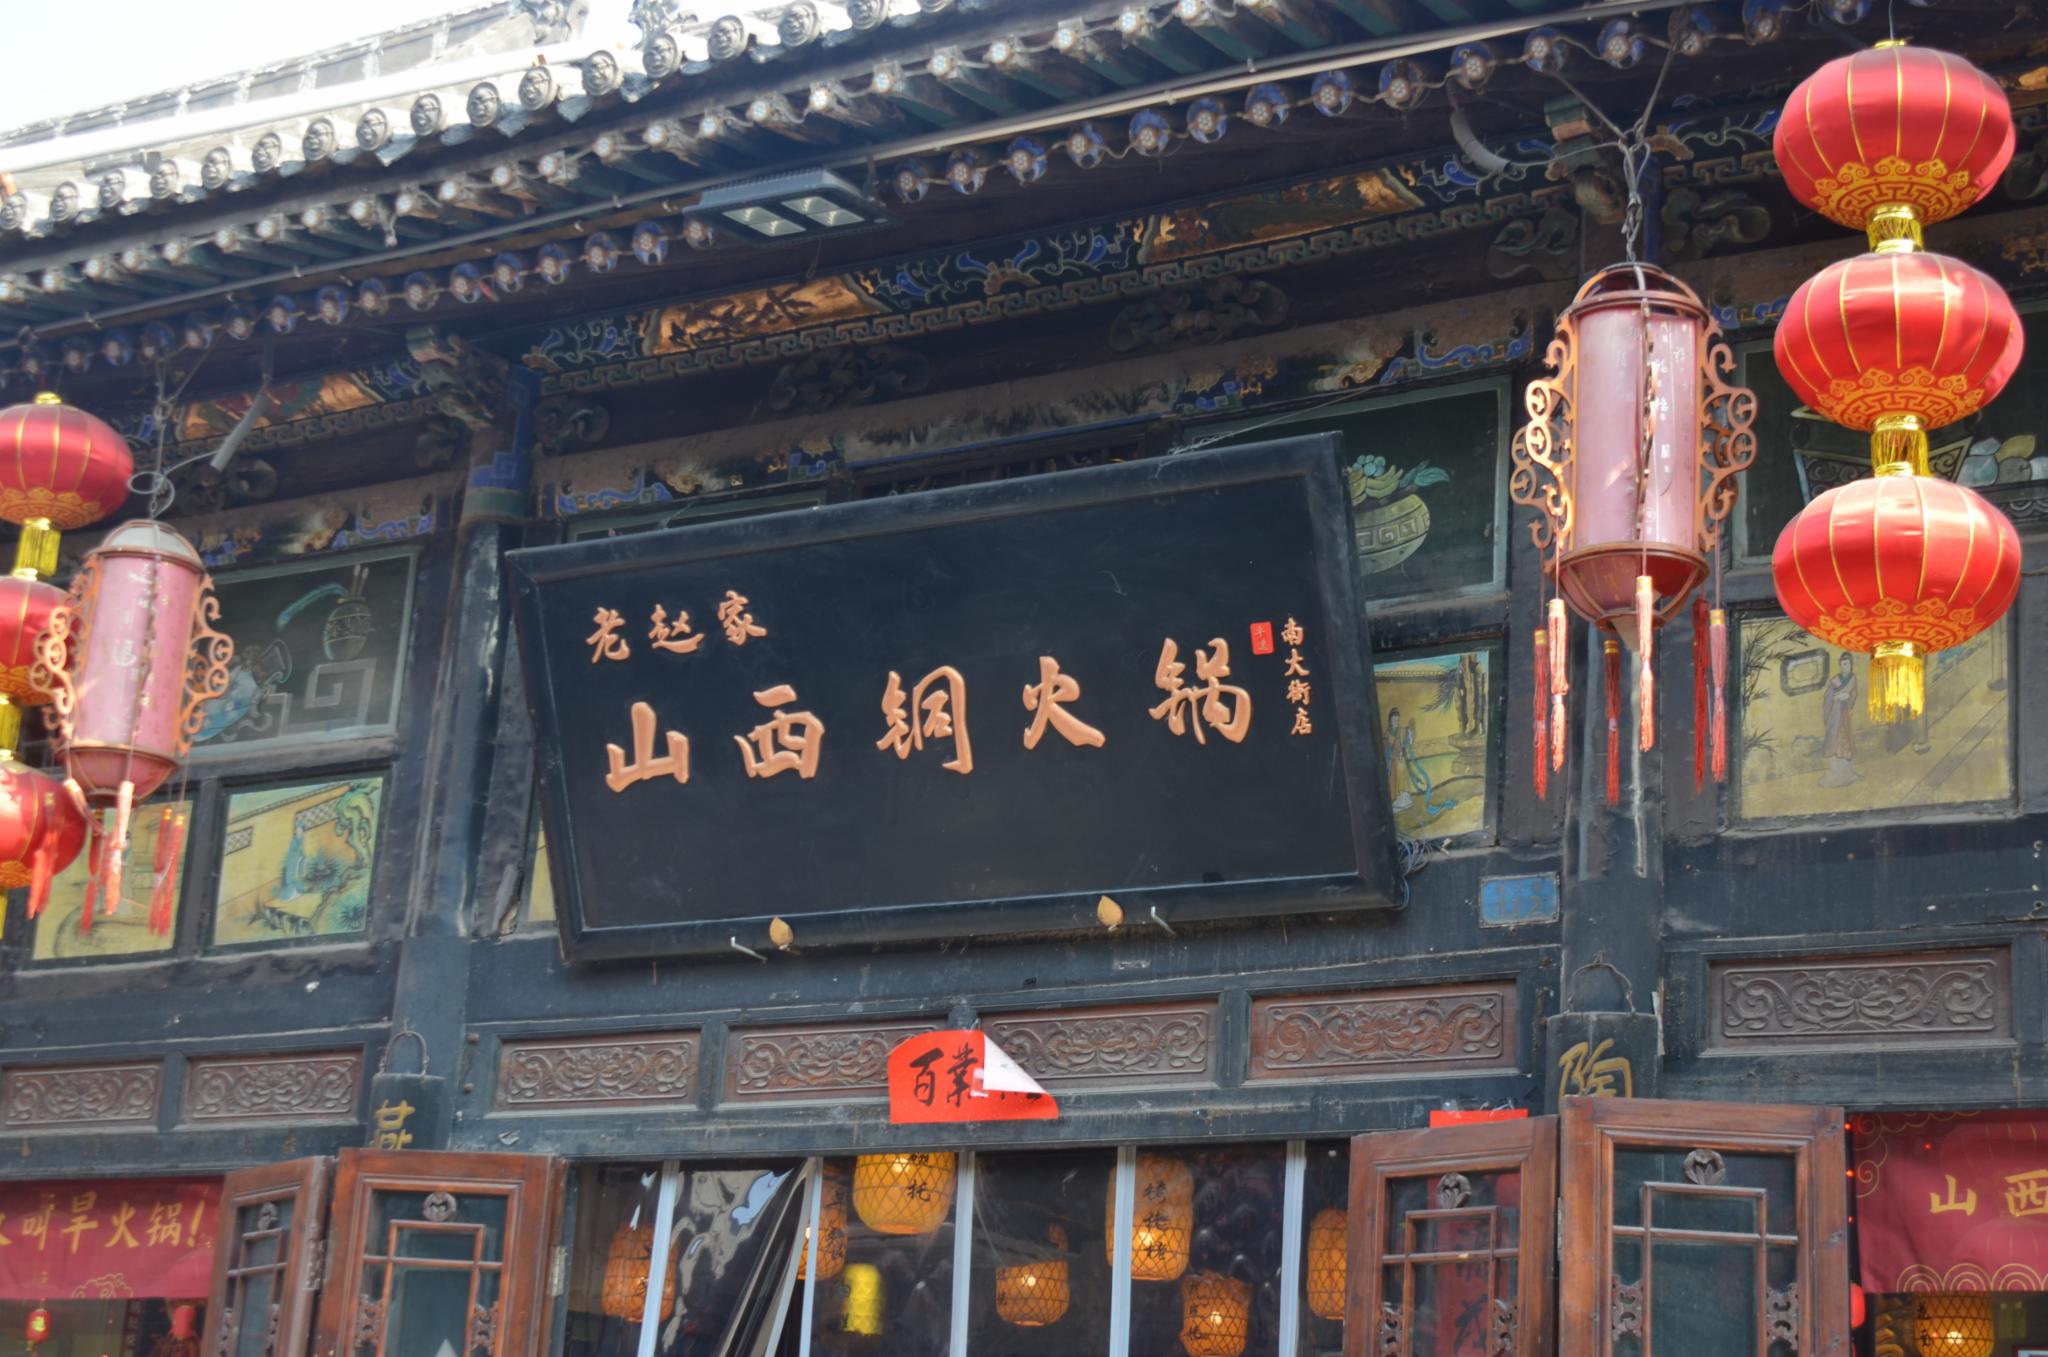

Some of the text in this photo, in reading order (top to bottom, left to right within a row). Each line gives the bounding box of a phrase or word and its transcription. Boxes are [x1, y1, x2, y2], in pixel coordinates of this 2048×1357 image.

[585, 590, 768, 664] 老赵家
[605, 637, 1252, 792] 山西铜火锅
[1281, 617, 1312, 735] 南大街店
[1929, 1169, 2048, 1217] 山西
